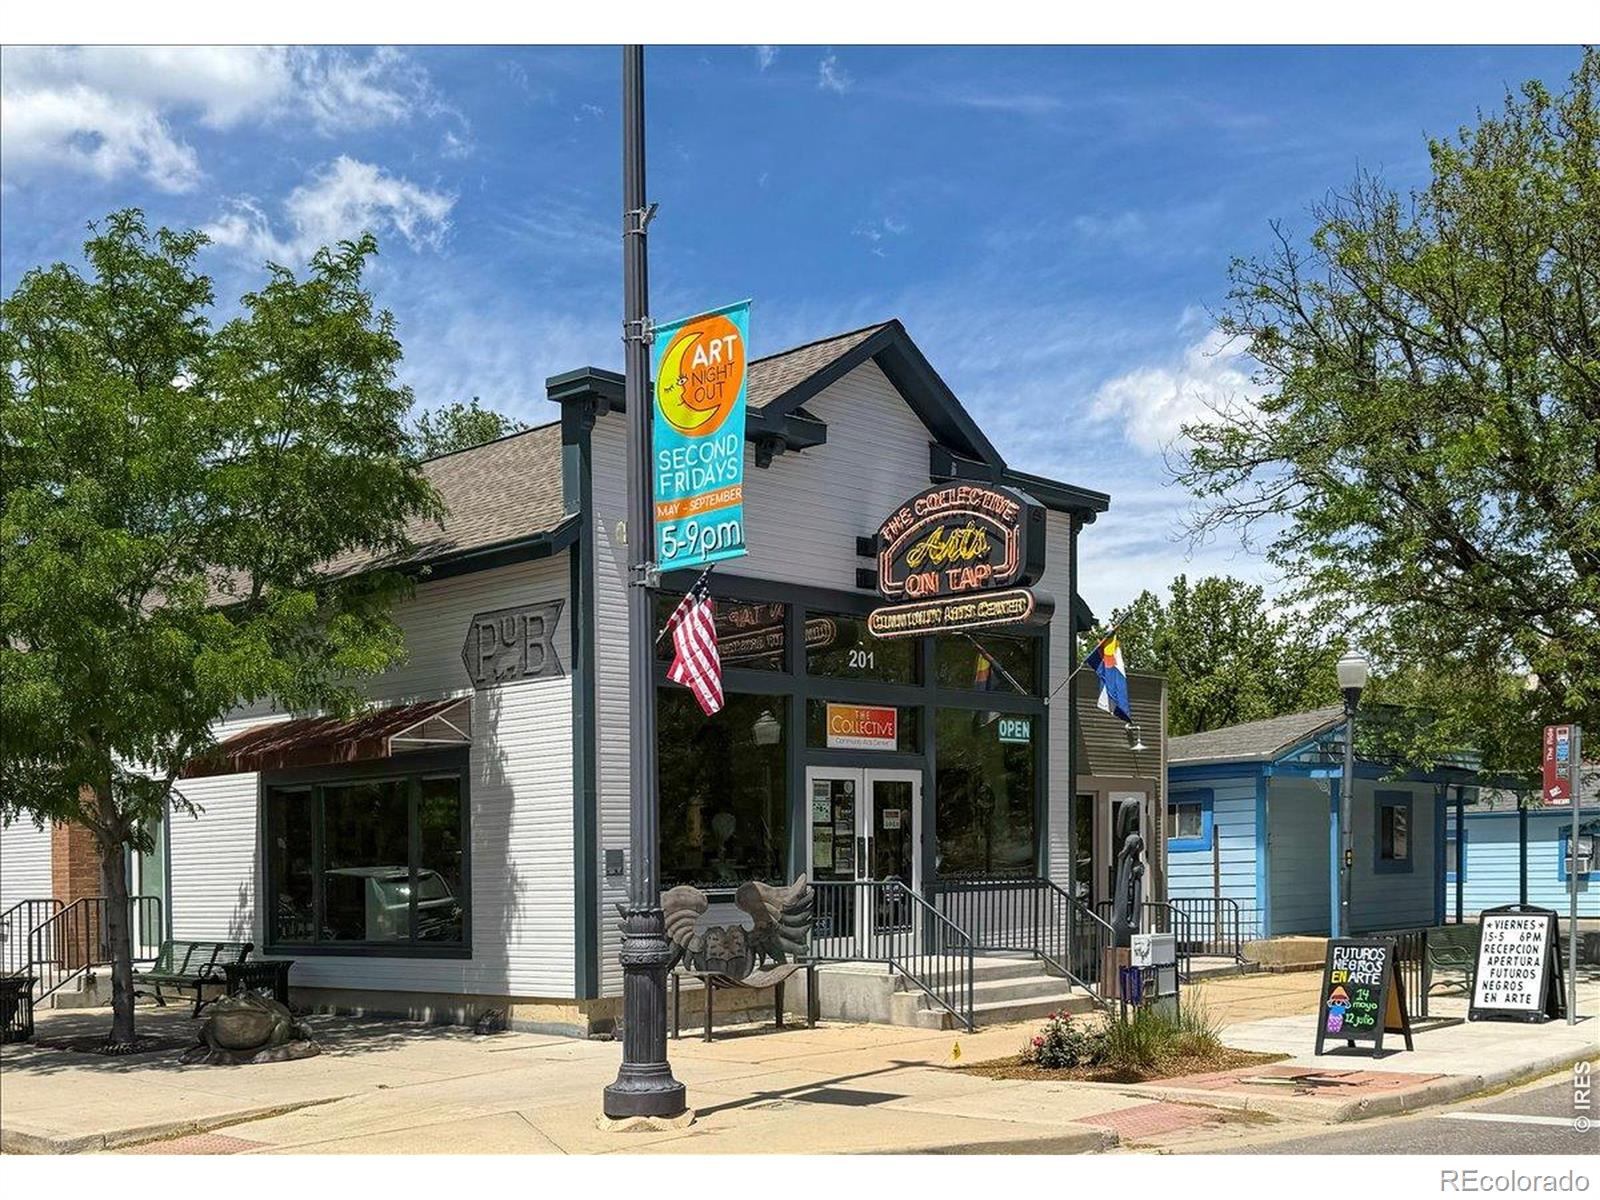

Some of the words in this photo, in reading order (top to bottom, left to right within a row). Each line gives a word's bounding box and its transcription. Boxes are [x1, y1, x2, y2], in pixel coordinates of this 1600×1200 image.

[691, 334, 737, 369] ART
[691, 361, 734, 387] NIGHT
[694, 381, 725, 403] OUT
[659, 434, 738, 471] SECOND
[660, 457, 738, 496] FRIDAYS
[656, 503, 681, 517] MAY
[689, 487, 743, 512] SEPTEMBER
[880, 506, 914, 542] THE
[914, 486, 1020, 521] COLLECTIVE
[661, 520, 745, 560] 5-9pm
[906, 520, 988, 568] Arts
[905, 571, 940, 598] ON
[945, 564, 992, 591] TAP
[944, 604, 976, 621] ARTS
[848, 649, 875, 669] 201
[855, 710, 871, 719] THE
[999, 719, 1030, 738] OPEN
[1494, 919, 1536, 930] VIERNES
[1519, 931, 1542, 942] 6PM
[1333, 946, 1386, 961] FUTUROS
[1484, 943, 1540, 954] RECEPCION
[1487, 956, 1541, 966] APERTURA
[1331, 970, 1348, 984] EN
[1347, 971, 1381, 985] ARTE
[1489, 968, 1536, 979] FUTUROS
[1482, 980, 1524, 991] NEGROS
[1356, 988, 1370, 1001] 14
[1484, 992, 1497, 1003] EN
[1504, 993, 1532, 1004] ARTE
[1352, 1002, 1378, 1012] mayo
[1345, 1012, 1354, 1024] 12
[1354, 1014, 1375, 1027] julio
